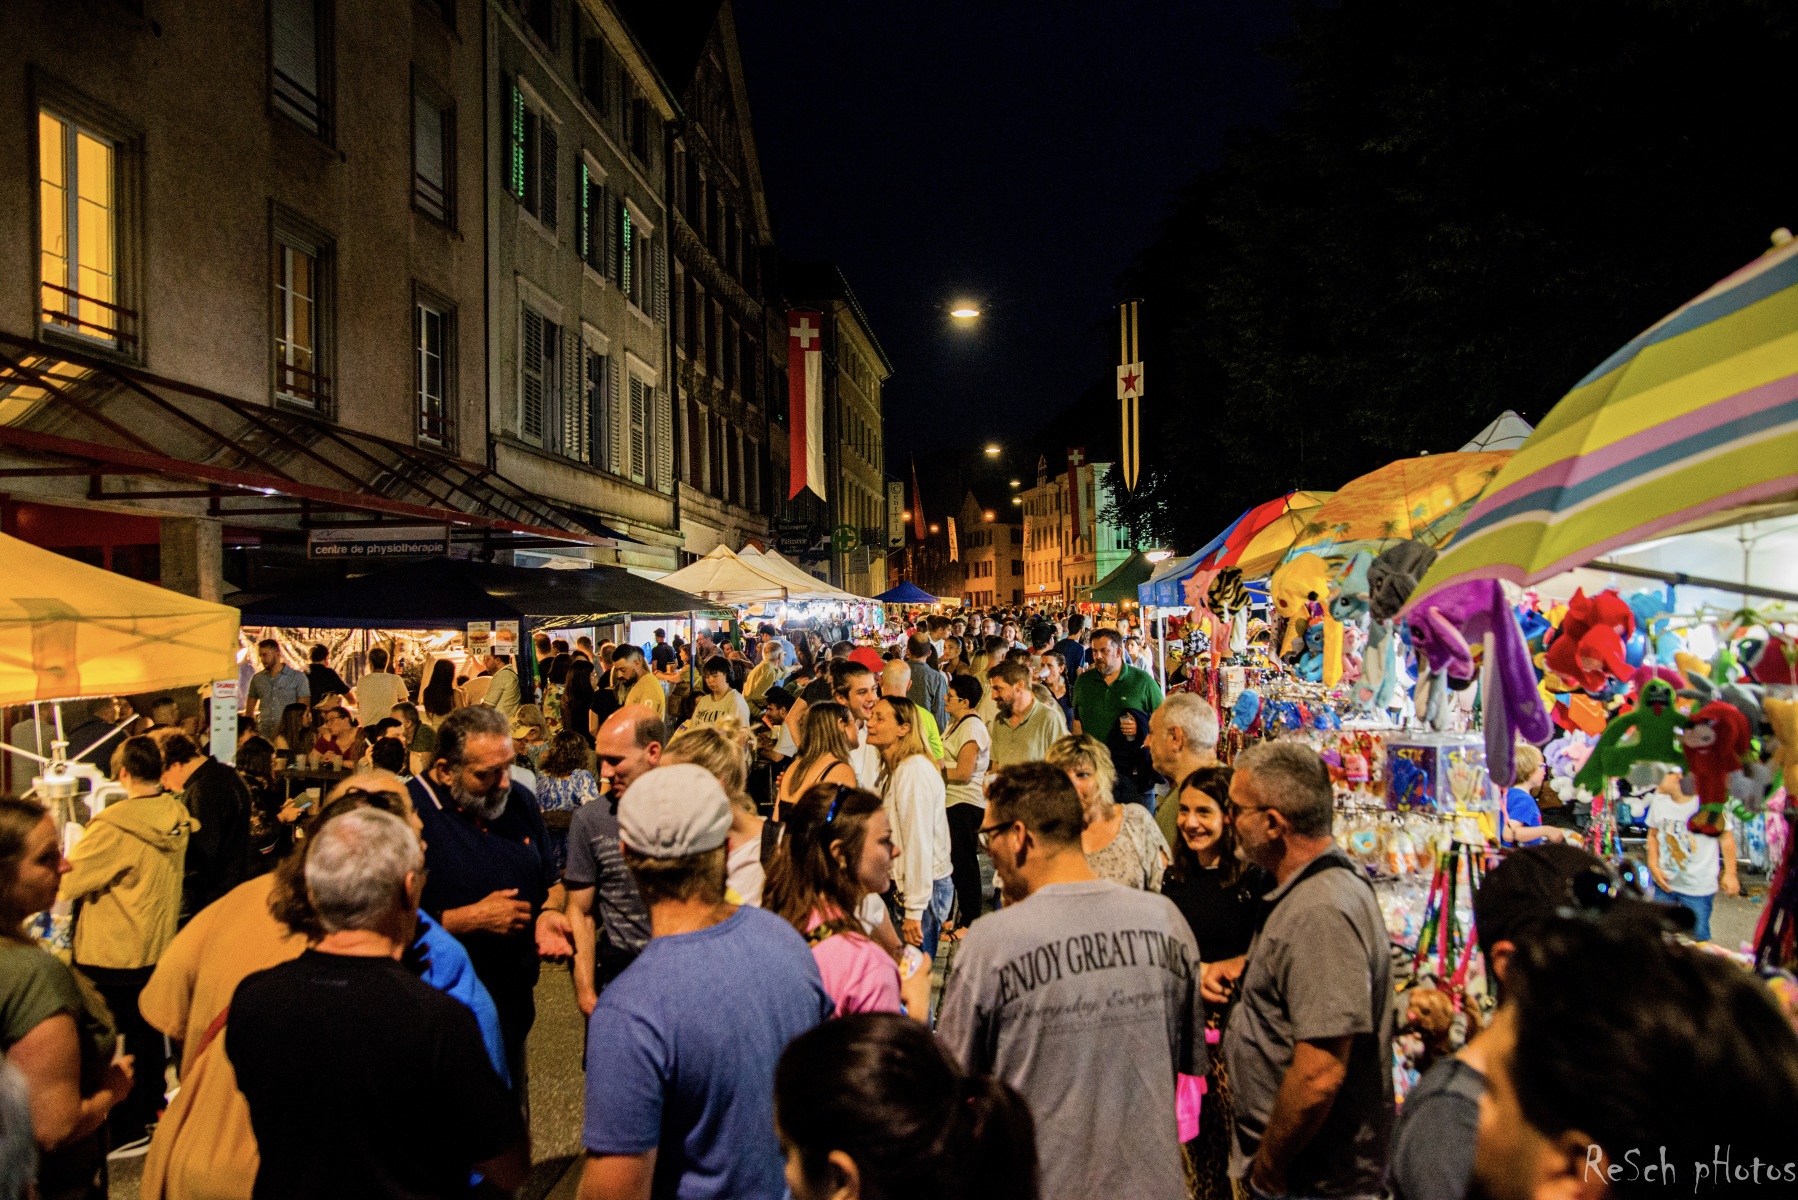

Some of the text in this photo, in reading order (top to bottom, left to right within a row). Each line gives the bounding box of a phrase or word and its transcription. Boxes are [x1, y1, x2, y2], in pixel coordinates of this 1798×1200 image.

[315, 542, 444, 556] centre de physiothérapie
[998, 940, 1062, 1005] ENJOY
[1066, 928, 1138, 975] GREAT
